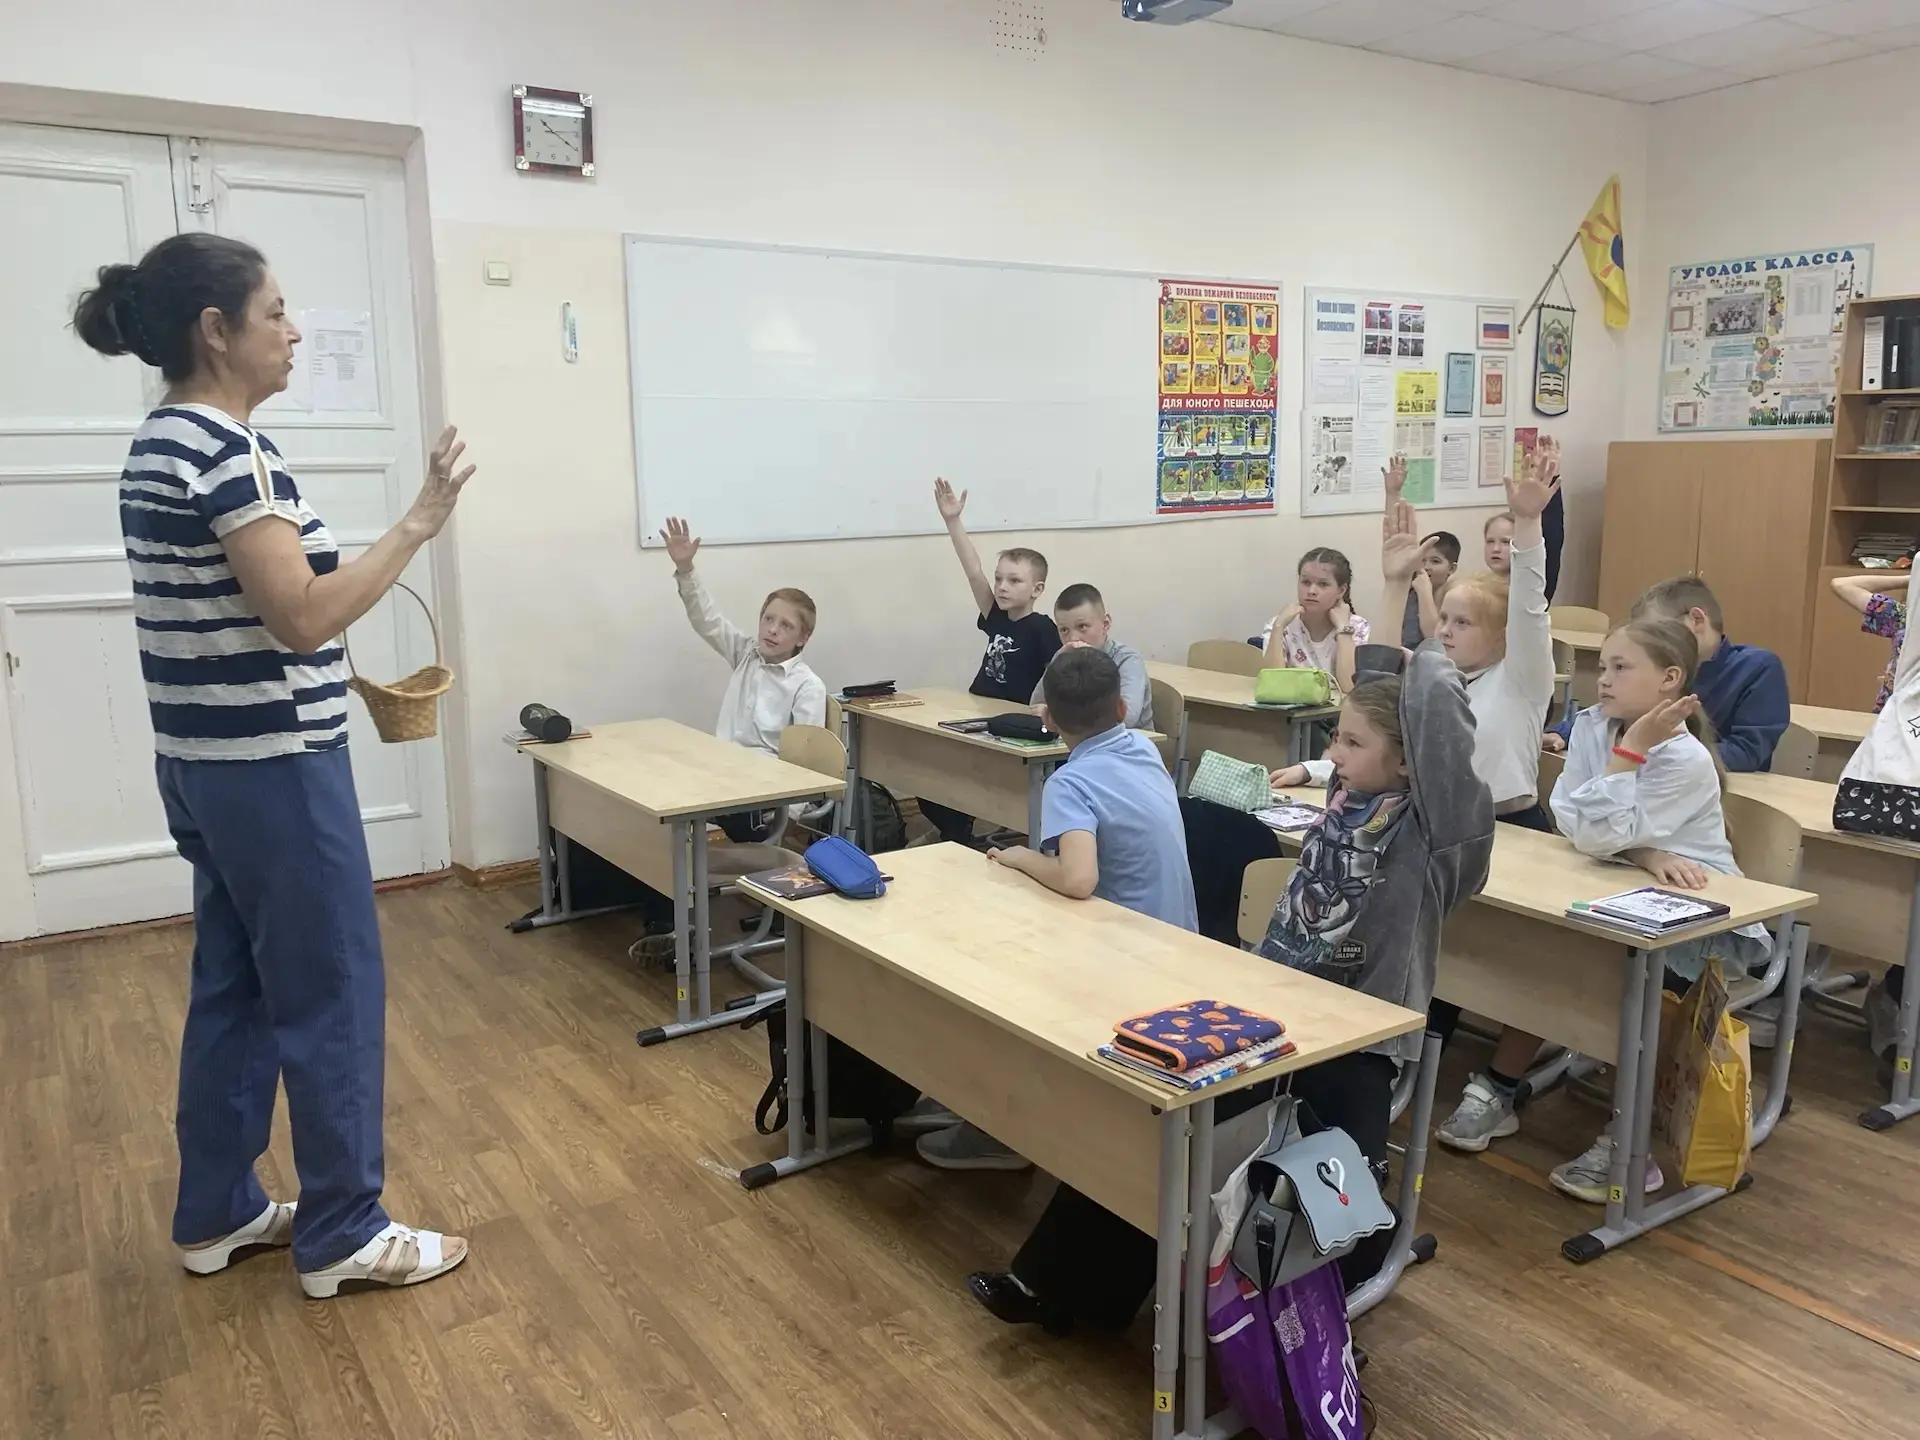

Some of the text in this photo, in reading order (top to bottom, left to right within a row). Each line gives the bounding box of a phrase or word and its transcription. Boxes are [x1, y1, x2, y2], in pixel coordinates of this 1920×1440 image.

[1682, 261, 1757, 279] УГОЛОК
[1765, 250, 1855, 270] КЛАССА
[1176, 287, 1277, 301] ПРАВИЛА ПОЖАРНОЙ БЕЗОПАСНОСТИ
[1162, 398, 1275, 409] ДЛЯ ЮНОГО ПЕШЕХОДА
[1612, 1189, 1620, 1200] 3
[1158, 1396, 1168, 1409] 3
